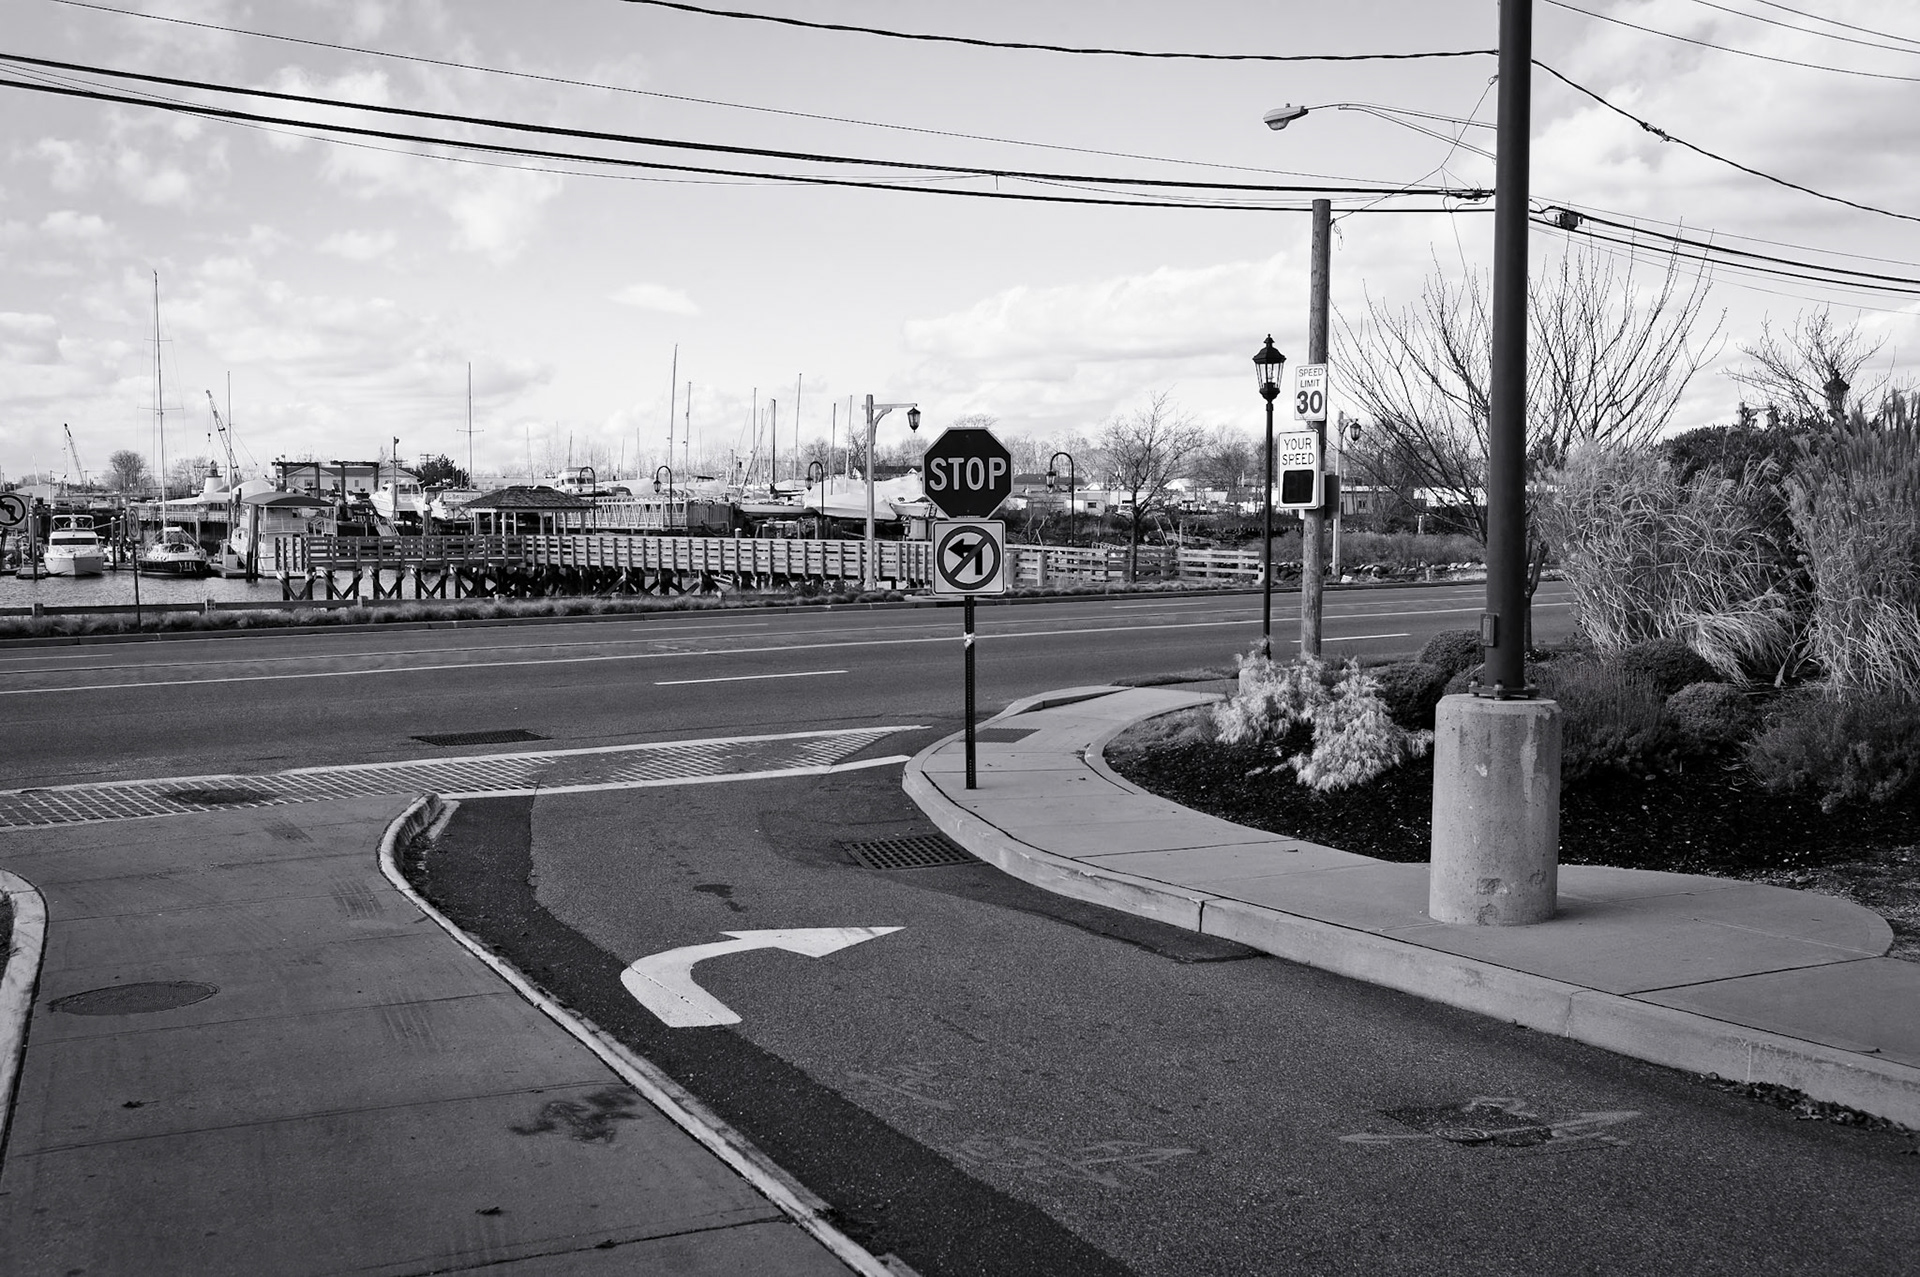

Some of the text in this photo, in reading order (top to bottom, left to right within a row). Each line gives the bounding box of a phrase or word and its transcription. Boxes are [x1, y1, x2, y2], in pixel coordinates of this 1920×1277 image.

[1298, 368, 1324, 378] SPEED
[1300, 379, 1320, 388] LIMIT
[1296, 390, 1322, 414] 30
[1283, 438, 1312, 450] YOUR
[1282, 452, 1314, 466] SPEED
[929, 457, 1006, 490] STOP
